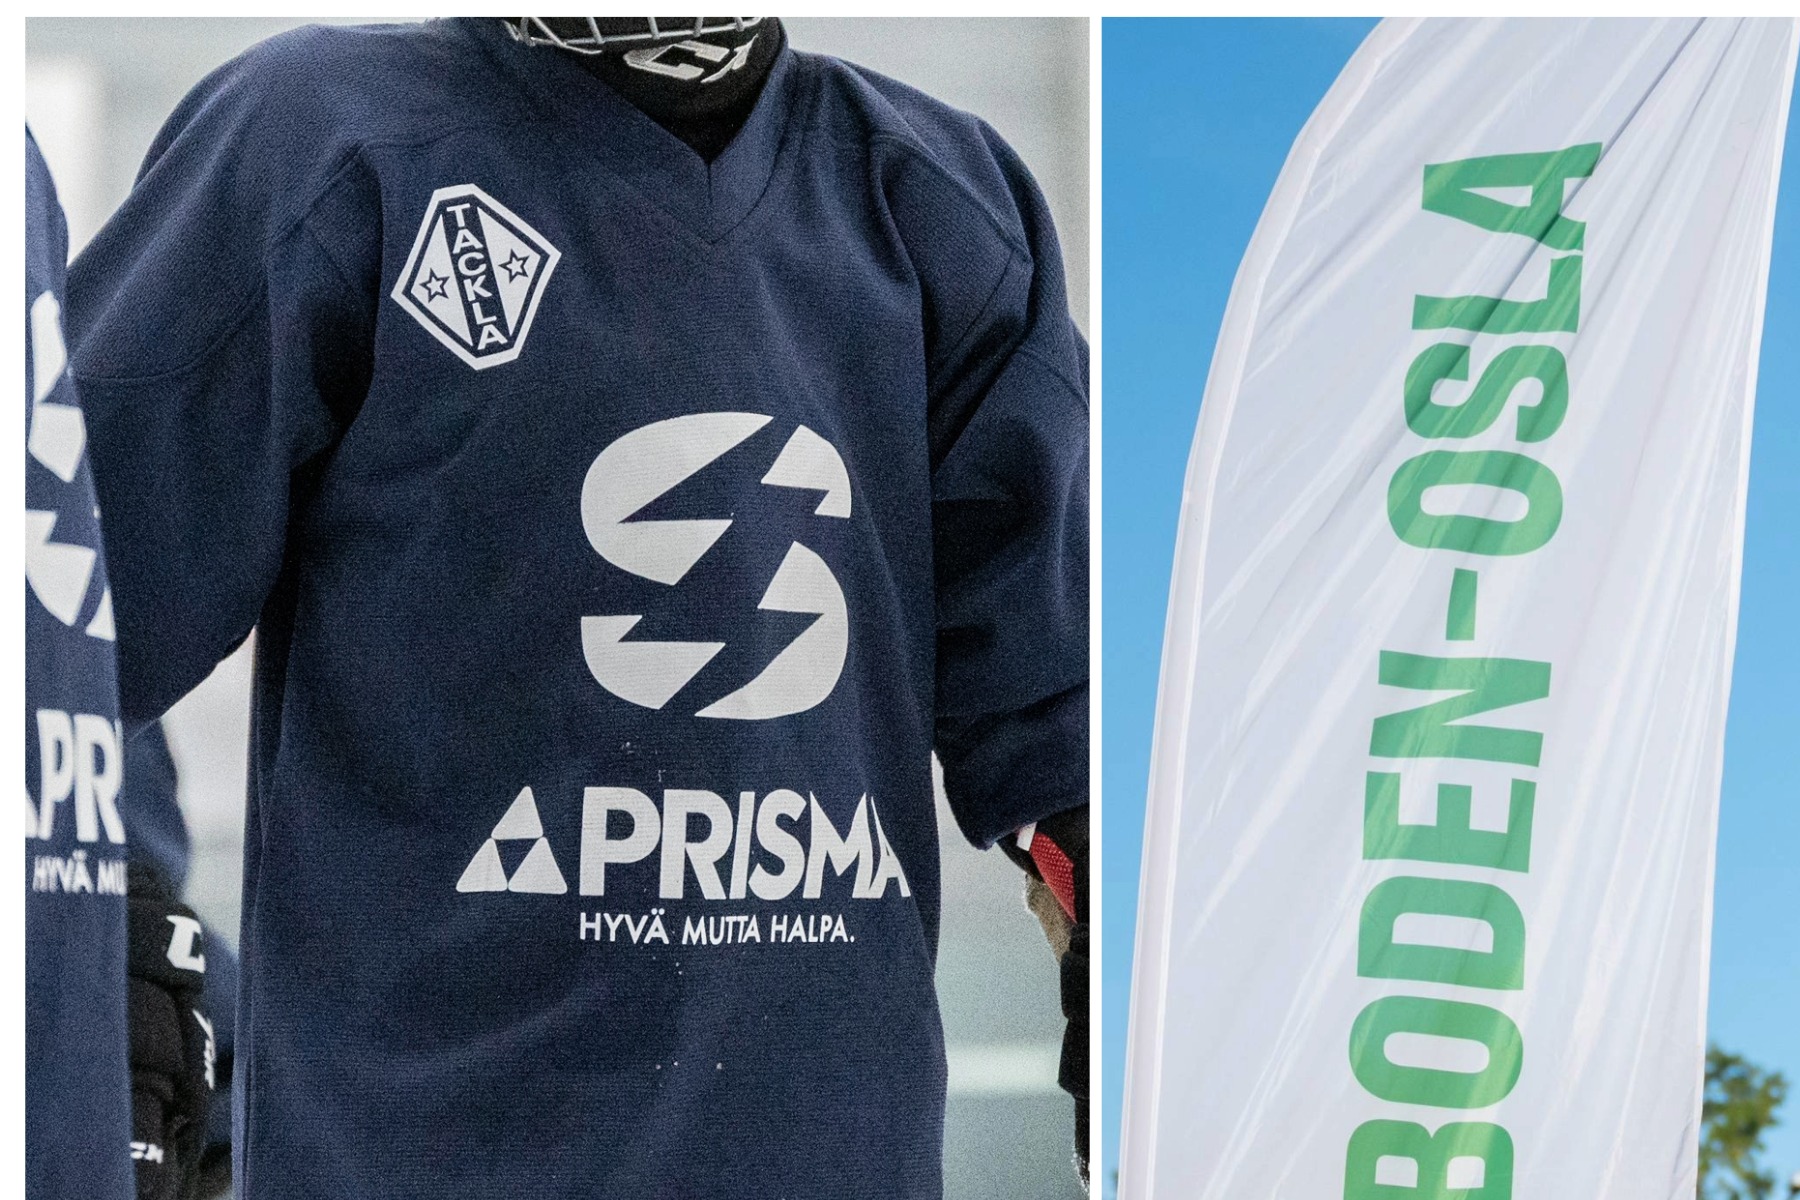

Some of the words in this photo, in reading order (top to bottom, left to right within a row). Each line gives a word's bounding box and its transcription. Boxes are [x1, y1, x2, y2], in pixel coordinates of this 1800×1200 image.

[446, 203, 508, 350] TACKLA
[579, 786, 911, 900] PRISMA
[579, 908, 669, 945] HYVÄ
[681, 914, 761, 946] MUTTA
[769, 913, 855, 944] HALPA.
